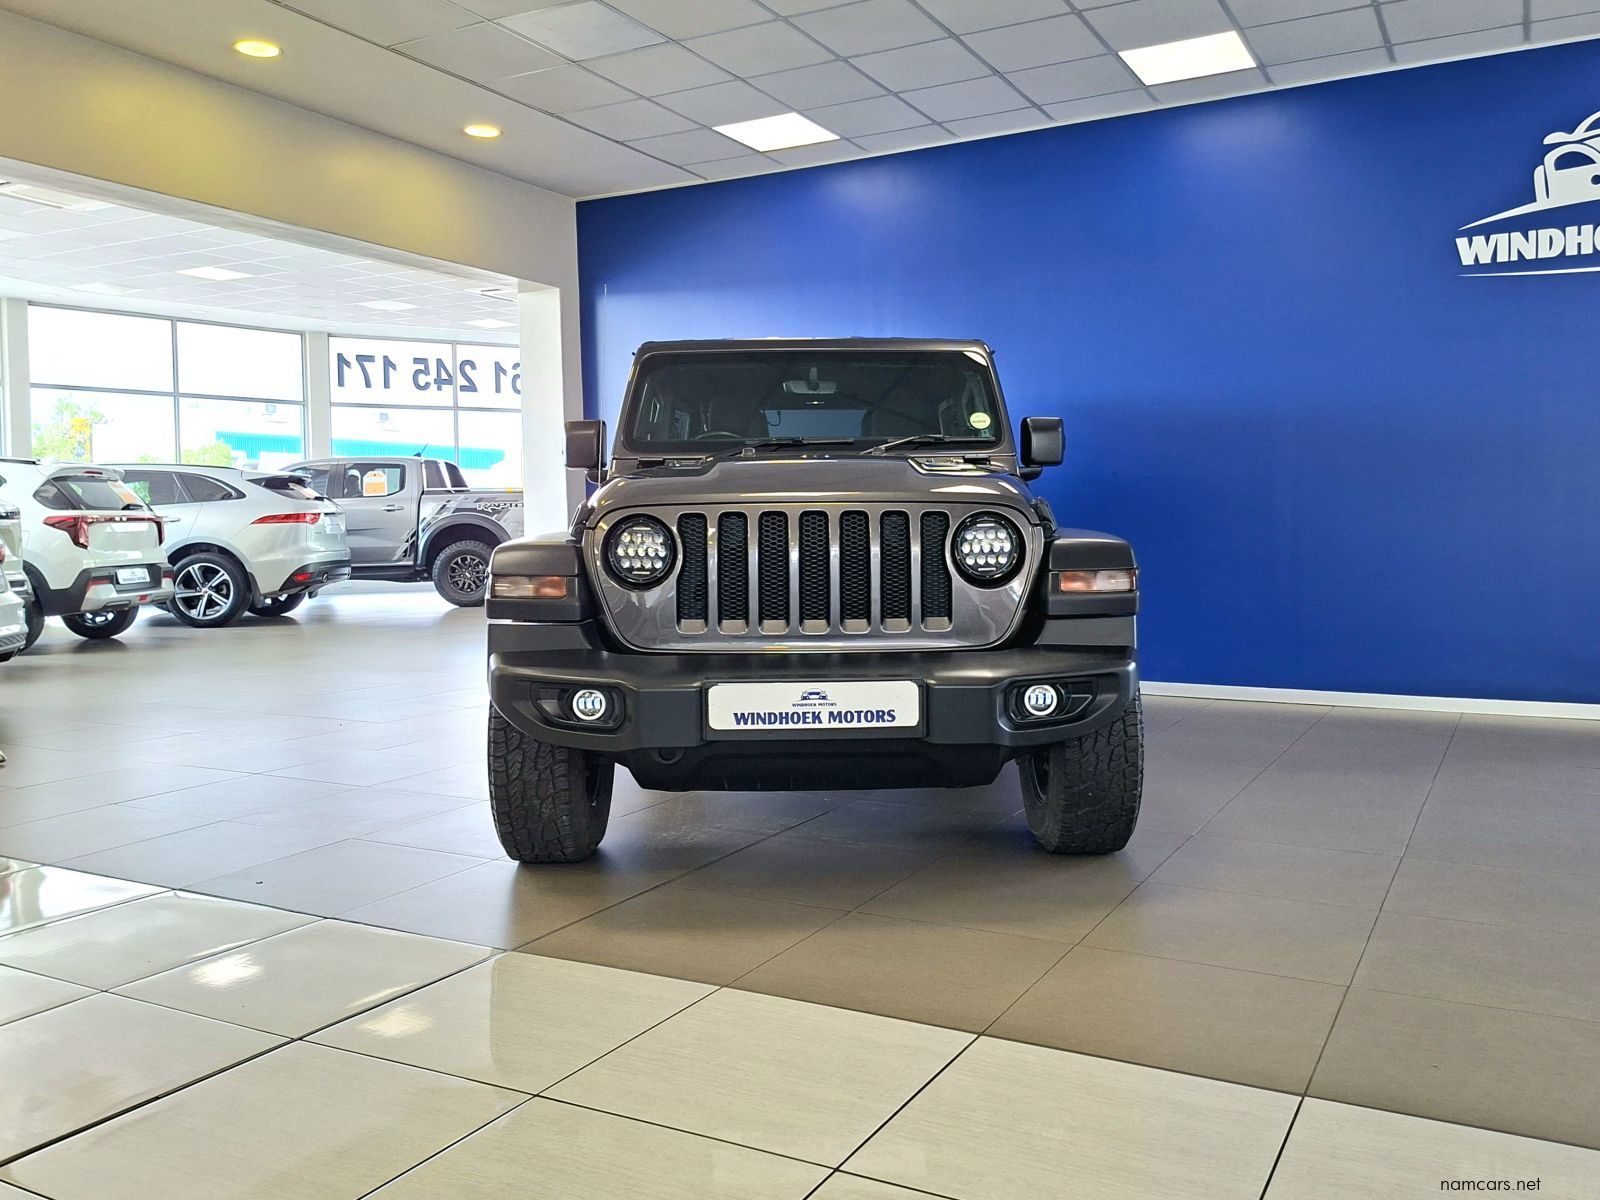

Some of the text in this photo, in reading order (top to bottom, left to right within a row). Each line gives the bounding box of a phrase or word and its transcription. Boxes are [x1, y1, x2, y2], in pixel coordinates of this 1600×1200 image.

[1455, 224, 1600, 266] WINDH
[733, 709, 896, 725] WINDHOEK MOTORS
